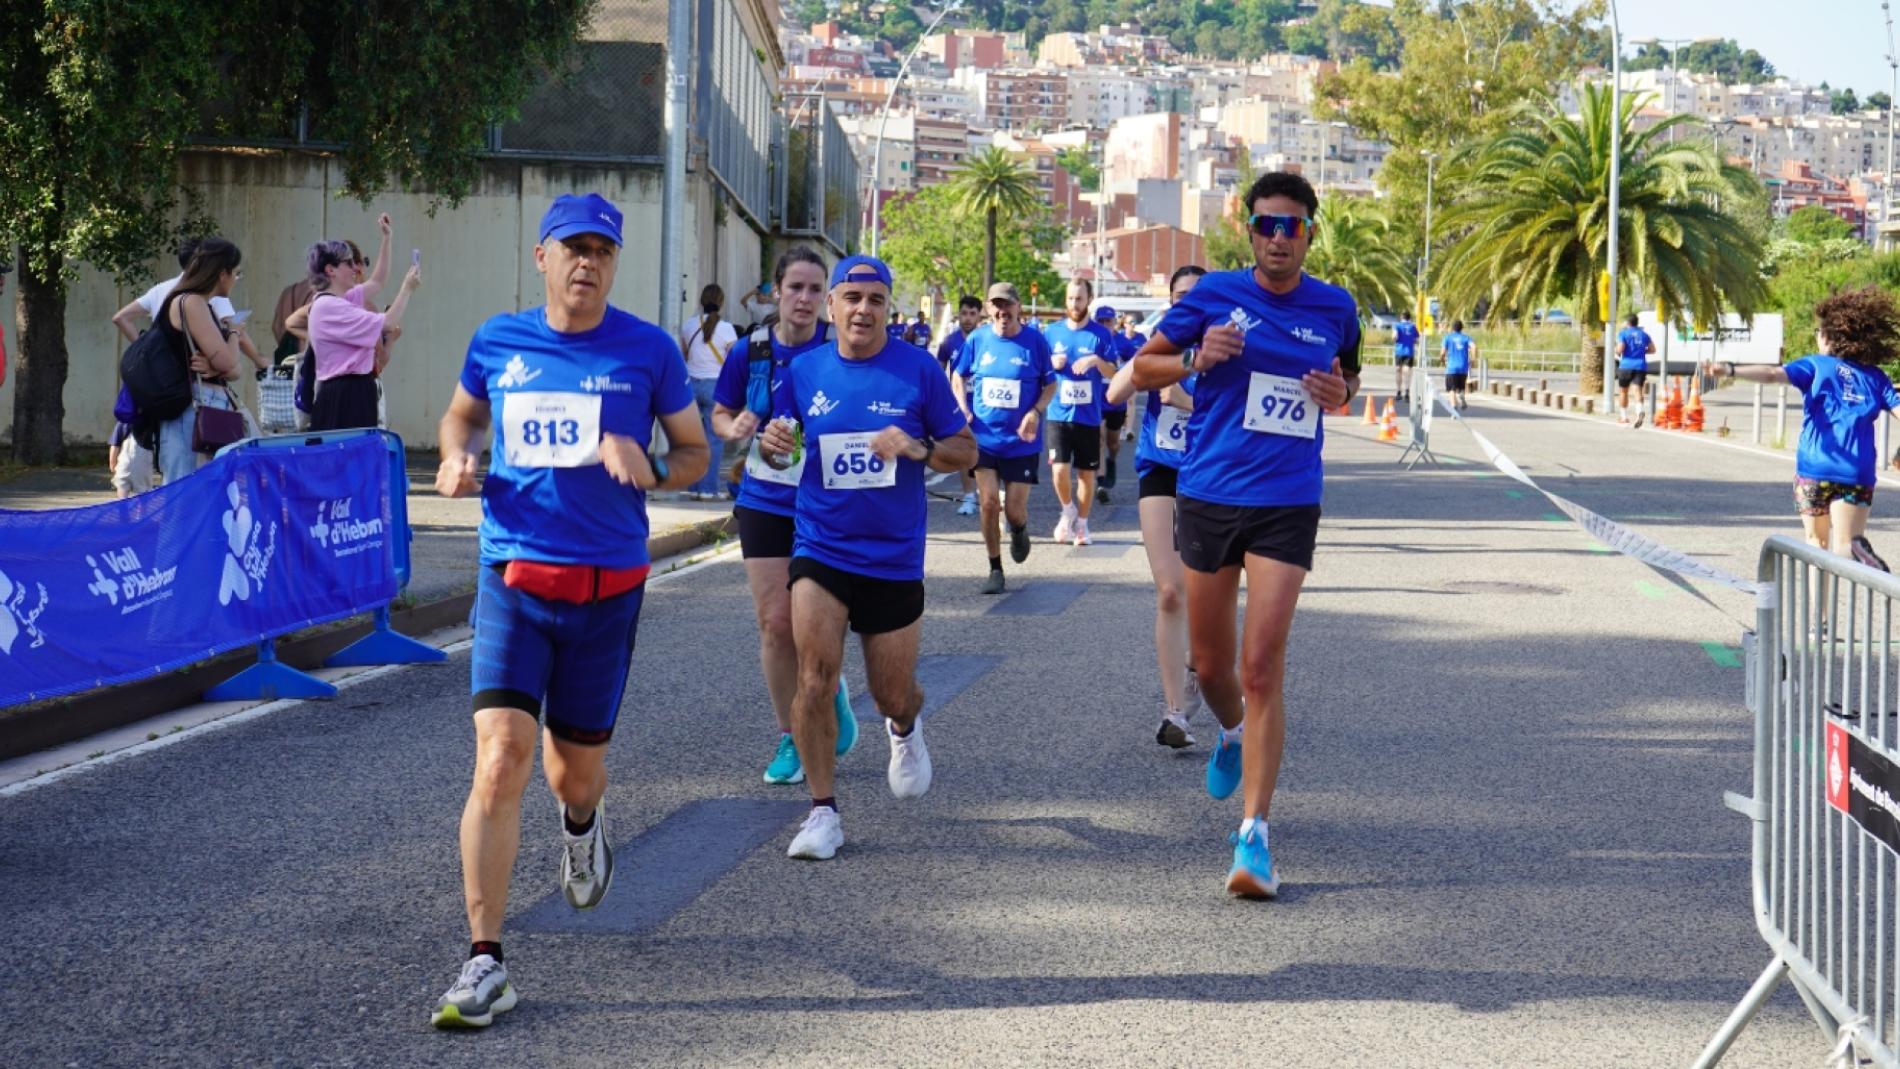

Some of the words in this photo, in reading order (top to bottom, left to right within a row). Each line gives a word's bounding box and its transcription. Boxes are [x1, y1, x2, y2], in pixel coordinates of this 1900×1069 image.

[988, 389, 1013, 401] 626
[1262, 395, 1305, 423] 976
[523, 419, 579, 445] 813
[833, 452, 884, 475] 656
[331, 497, 351, 520] Vall
[101, 546, 142, 575] Vall
